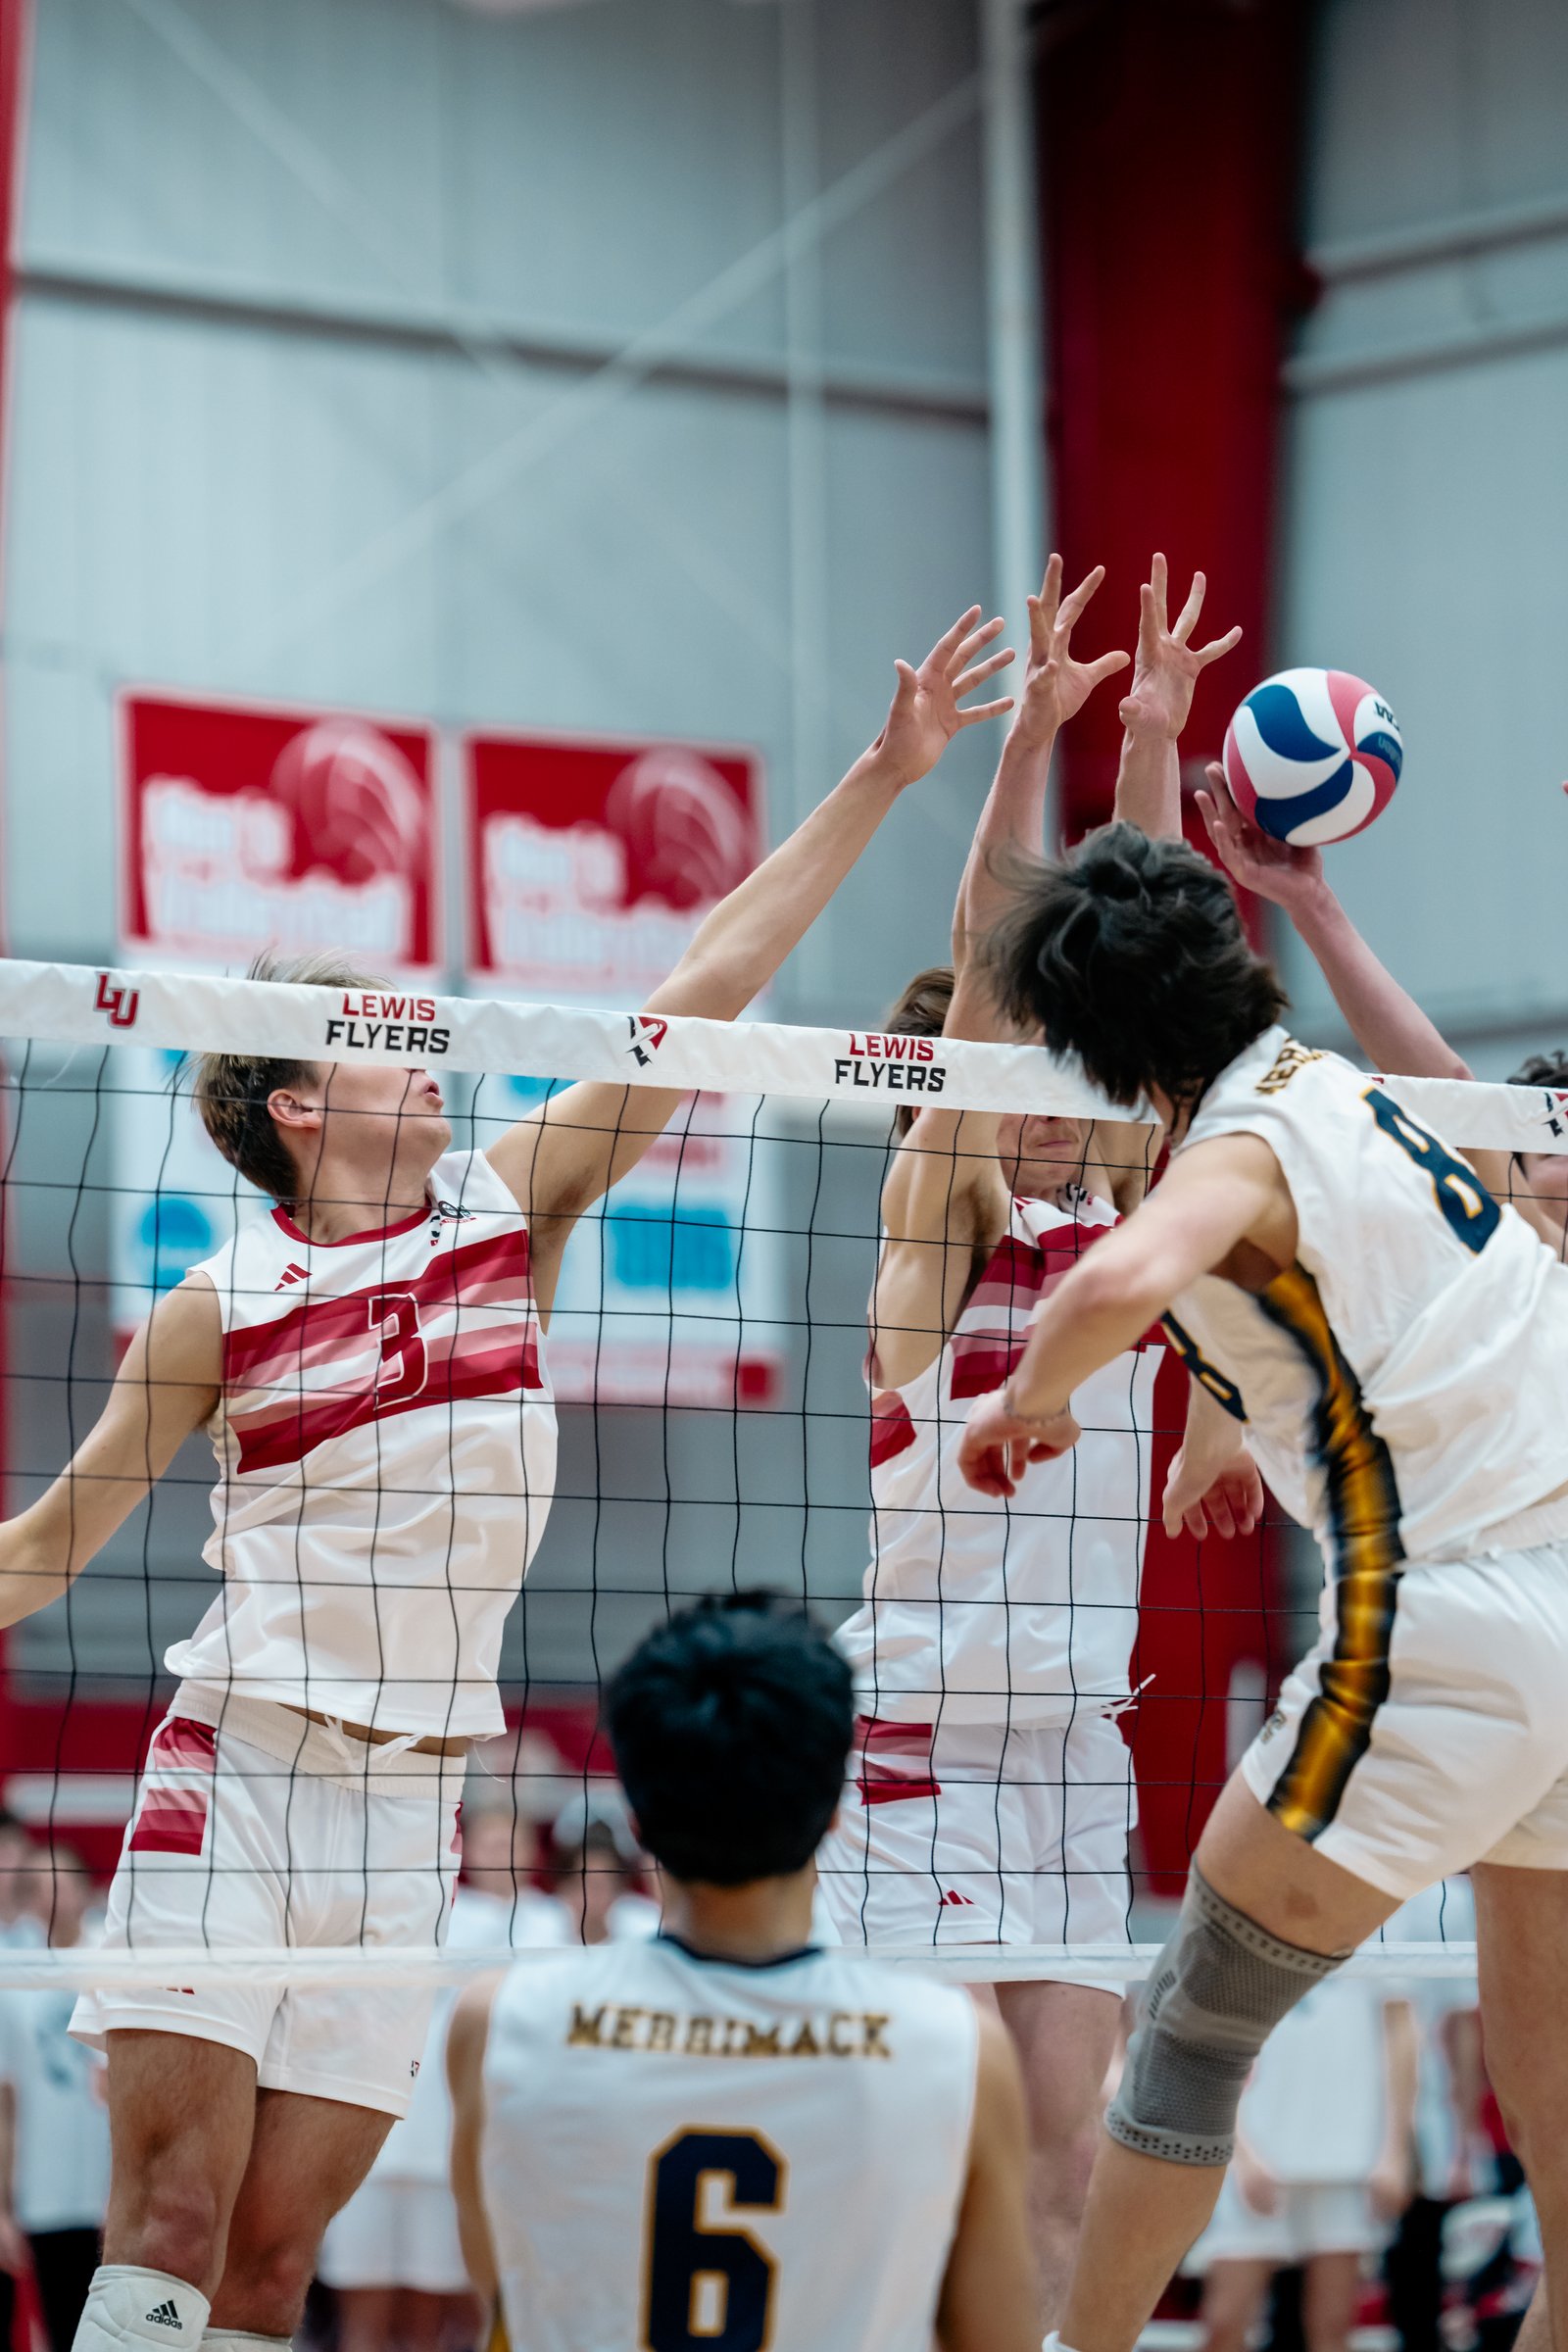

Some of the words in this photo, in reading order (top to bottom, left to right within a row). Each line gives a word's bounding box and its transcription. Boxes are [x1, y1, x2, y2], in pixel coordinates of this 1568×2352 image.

[343, 993, 436, 1021] LEWIS
[325, 1020, 450, 1054] FLYERS
[849, 1033, 934, 1061] LEWIS
[834, 1059, 946, 1092] FLYERS
[1360, 1085, 1502, 1257] 8
[368, 1292, 428, 1411] 3
[566, 2002, 894, 2060] MERRIMACK
[639, 2124, 789, 2352] 6
[146, 2313, 183, 2330] adidas
